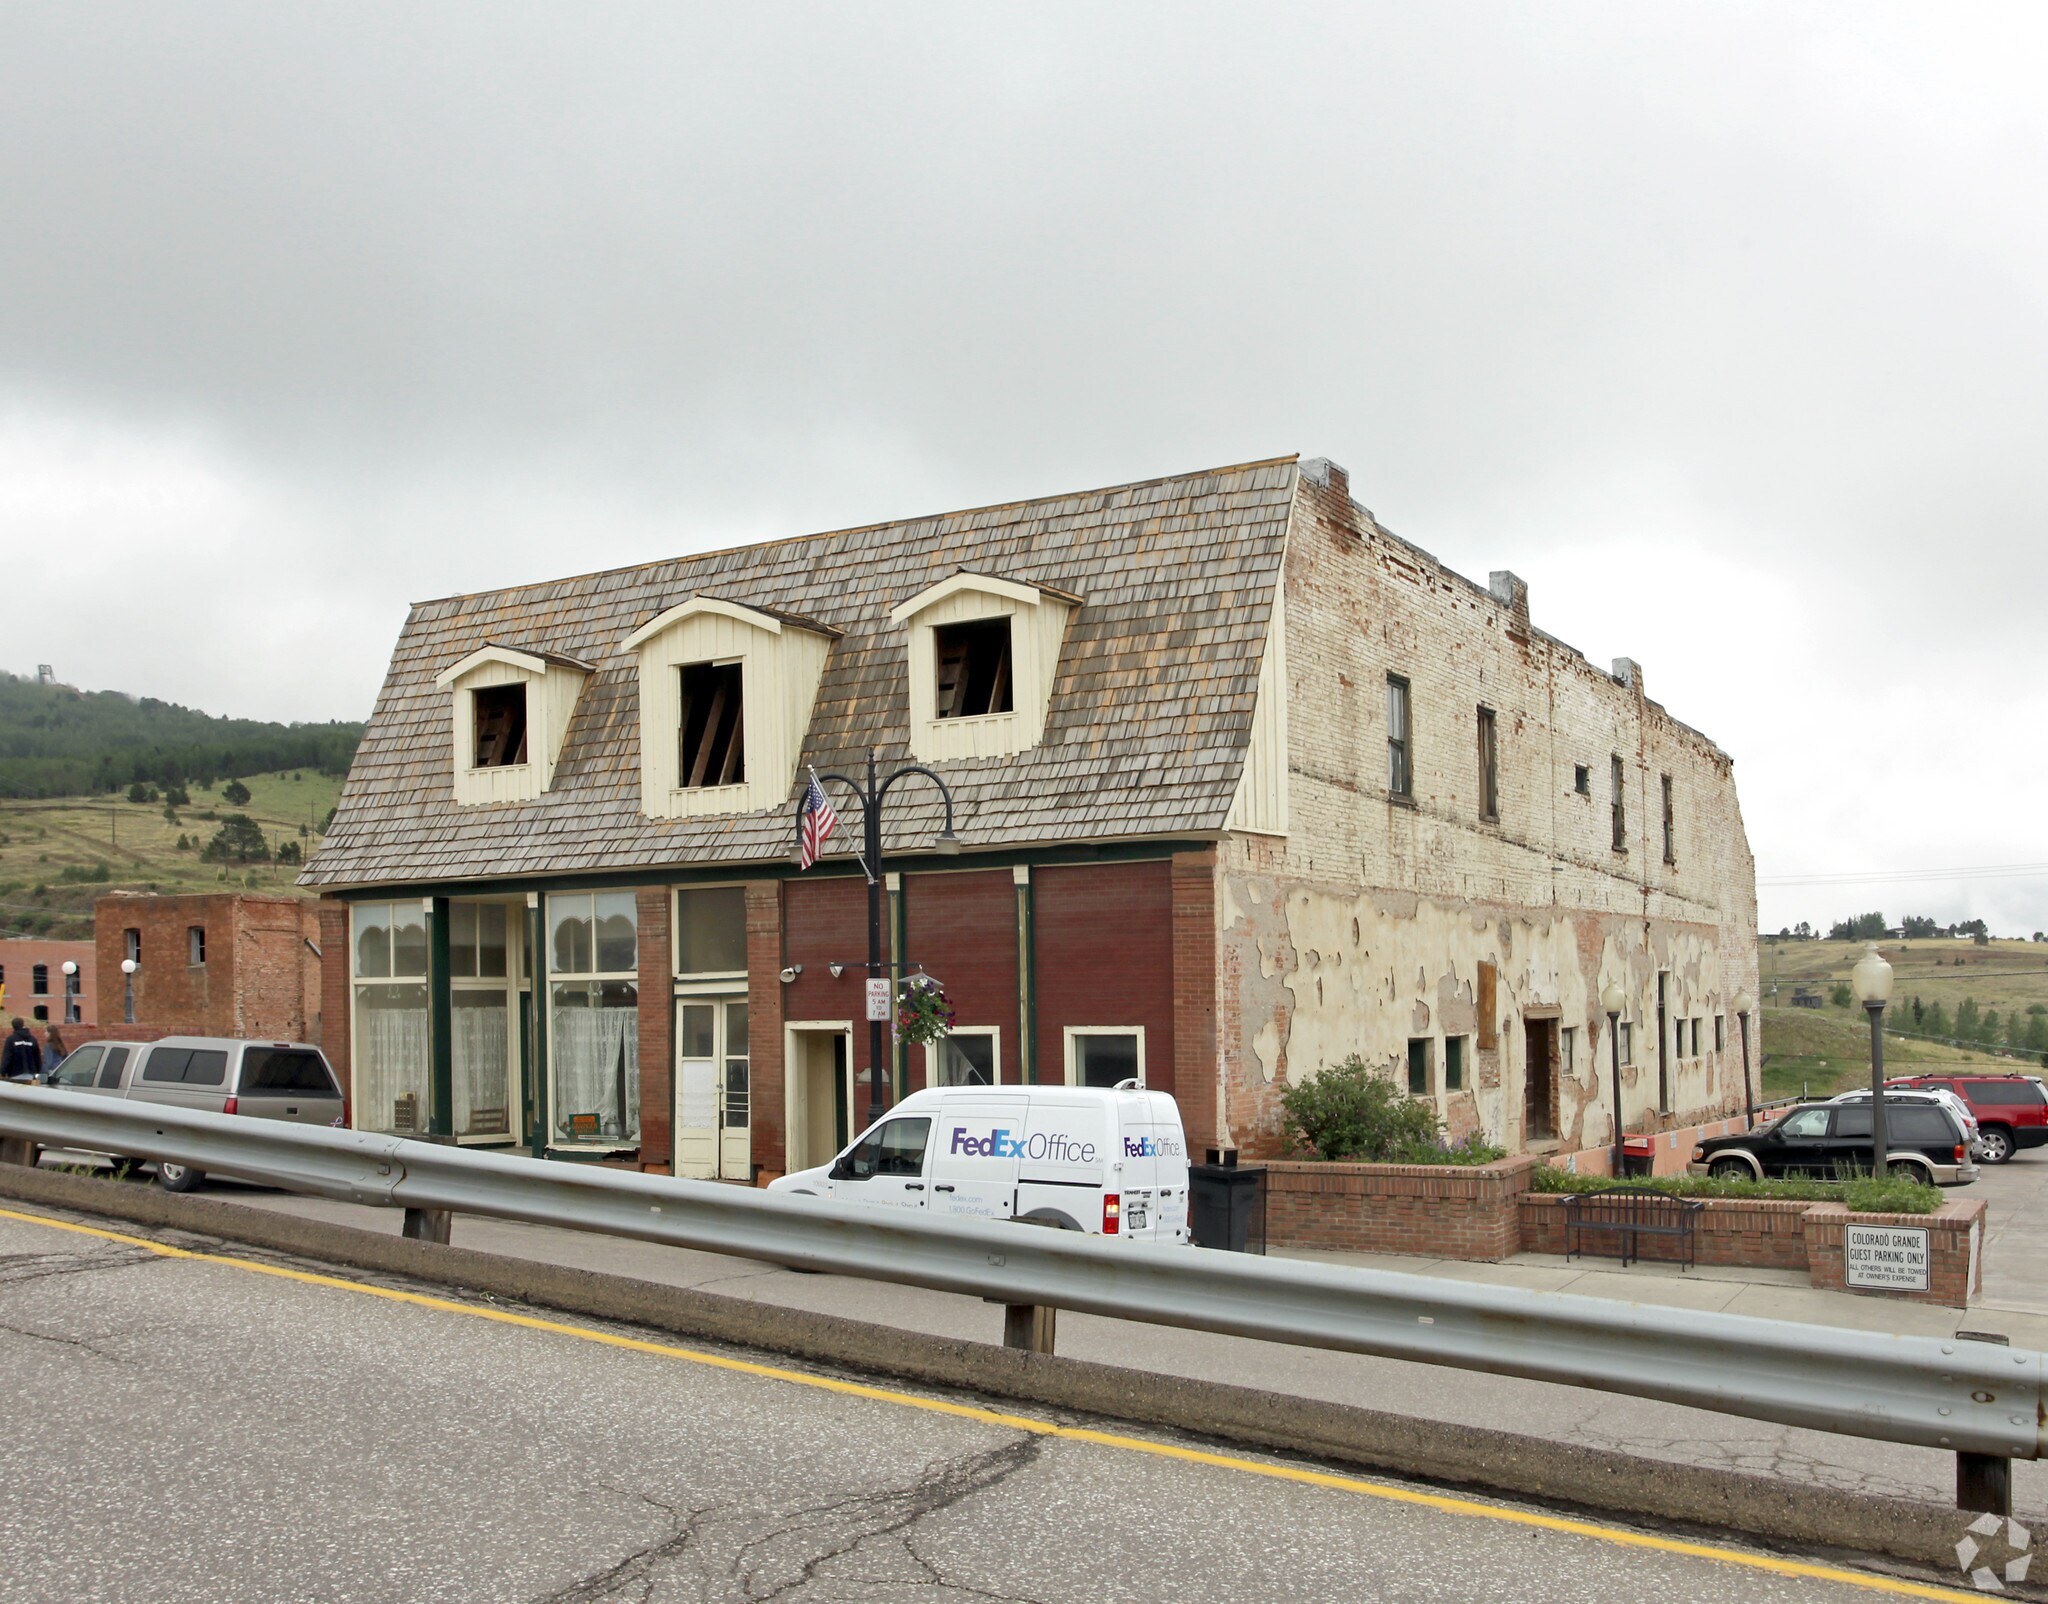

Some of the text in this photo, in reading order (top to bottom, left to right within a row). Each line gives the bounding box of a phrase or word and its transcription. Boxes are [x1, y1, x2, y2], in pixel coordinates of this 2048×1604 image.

[950, 1127, 1027, 1159] FedEx
[1028, 1133, 1096, 1163] Office
[1123, 1136, 1180, 1157] FedEx Office
[1852, 1233, 1920, 1248] COLORADO GRANDE
[1850, 1248, 1924, 1264] GUEST PARKING ONLY
[1861, 1264, 1881, 1272] OTHERS
[1892, 1275, 1916, 1283] EXPENSE
